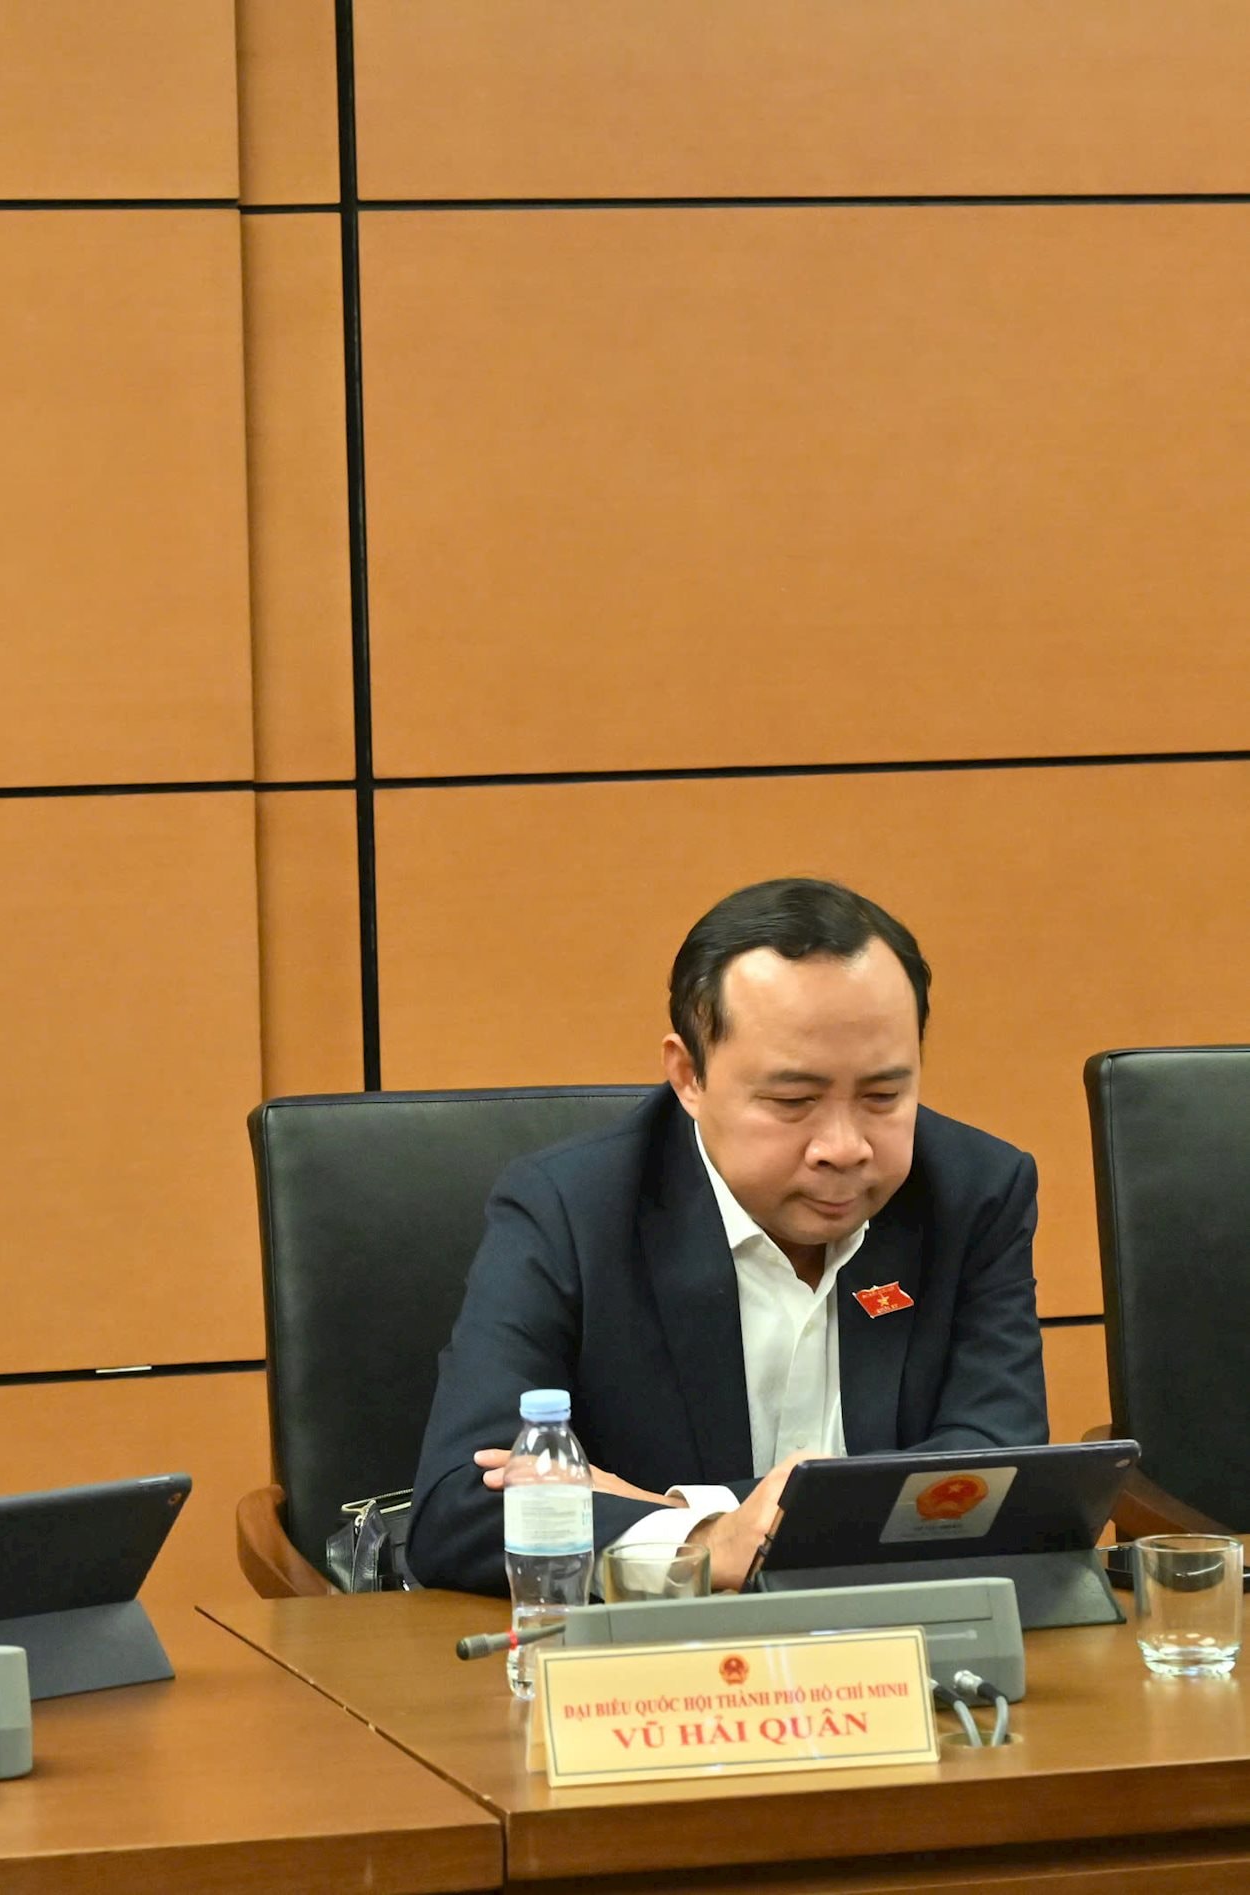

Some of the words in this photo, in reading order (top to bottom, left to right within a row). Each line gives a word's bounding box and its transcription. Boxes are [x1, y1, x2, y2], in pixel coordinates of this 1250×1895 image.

[563, 1703, 591, 1721] ĐẠI
[635, 1695, 680, 1716] QUỐC
[683, 1694, 713, 1713] HỘI
[716, 1689, 770, 1709] THÀNH
[773, 1686, 806, 1705] PHỐ
[810, 1684, 833, 1702] HỒ
[836, 1682, 864, 1701] CHÍ
[867, 1683, 909, 1699] MINH
[612, 1720, 665, 1750] VŨ
[678, 1715, 749, 1746] HẢI
[759, 1707, 868, 1745] QUÂN
